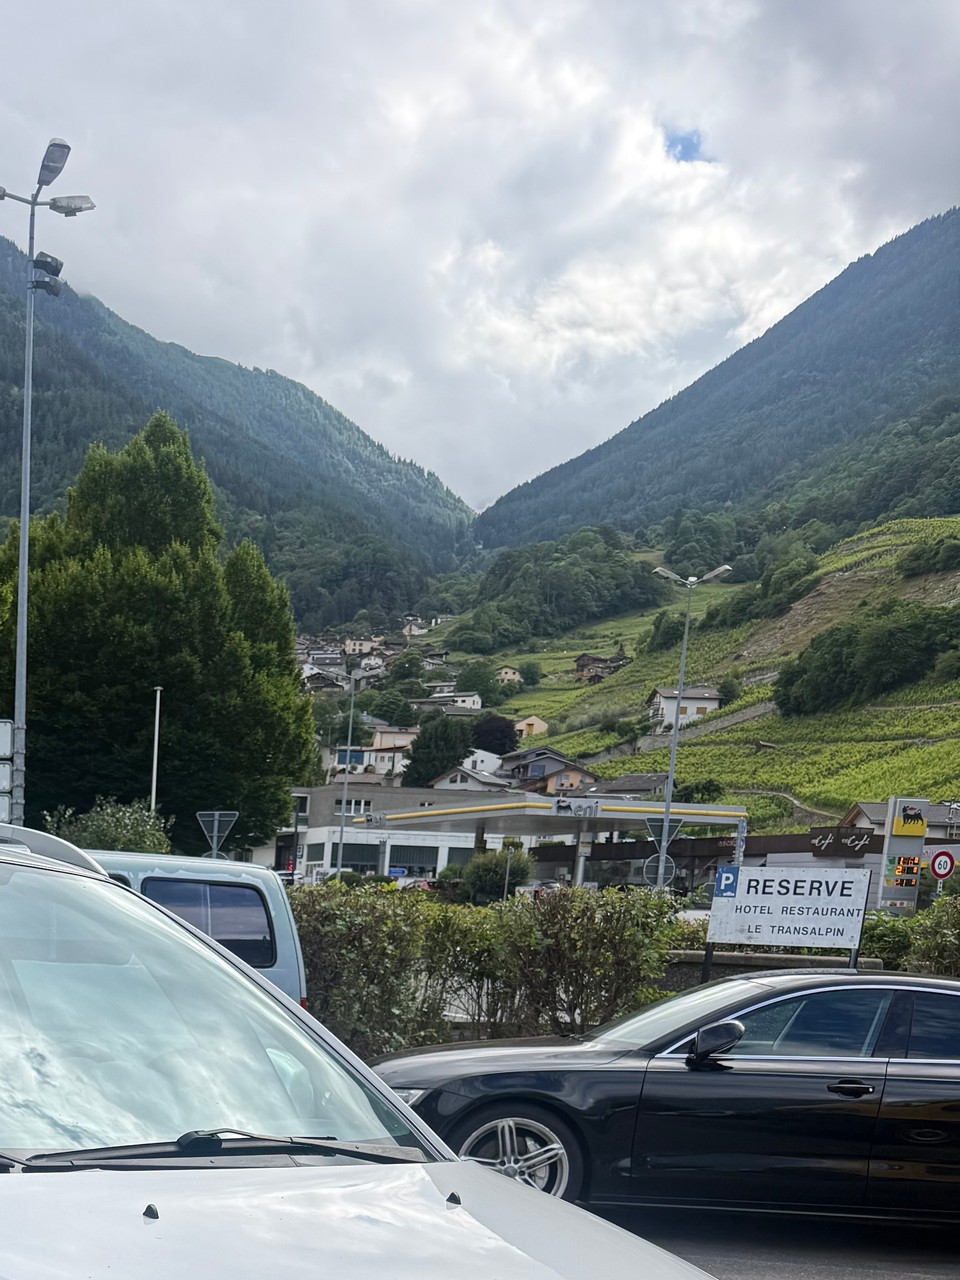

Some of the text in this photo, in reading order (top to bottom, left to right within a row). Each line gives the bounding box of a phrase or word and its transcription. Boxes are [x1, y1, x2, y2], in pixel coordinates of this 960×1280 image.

[937, 860, 948, 870] 60
[720, 873, 734, 890] P
[746, 878, 855, 897] RESERVE
[734, 905, 863, 918] HOTEL RESTAURANT
[747, 924, 845, 937] LE TRANSALPIN
